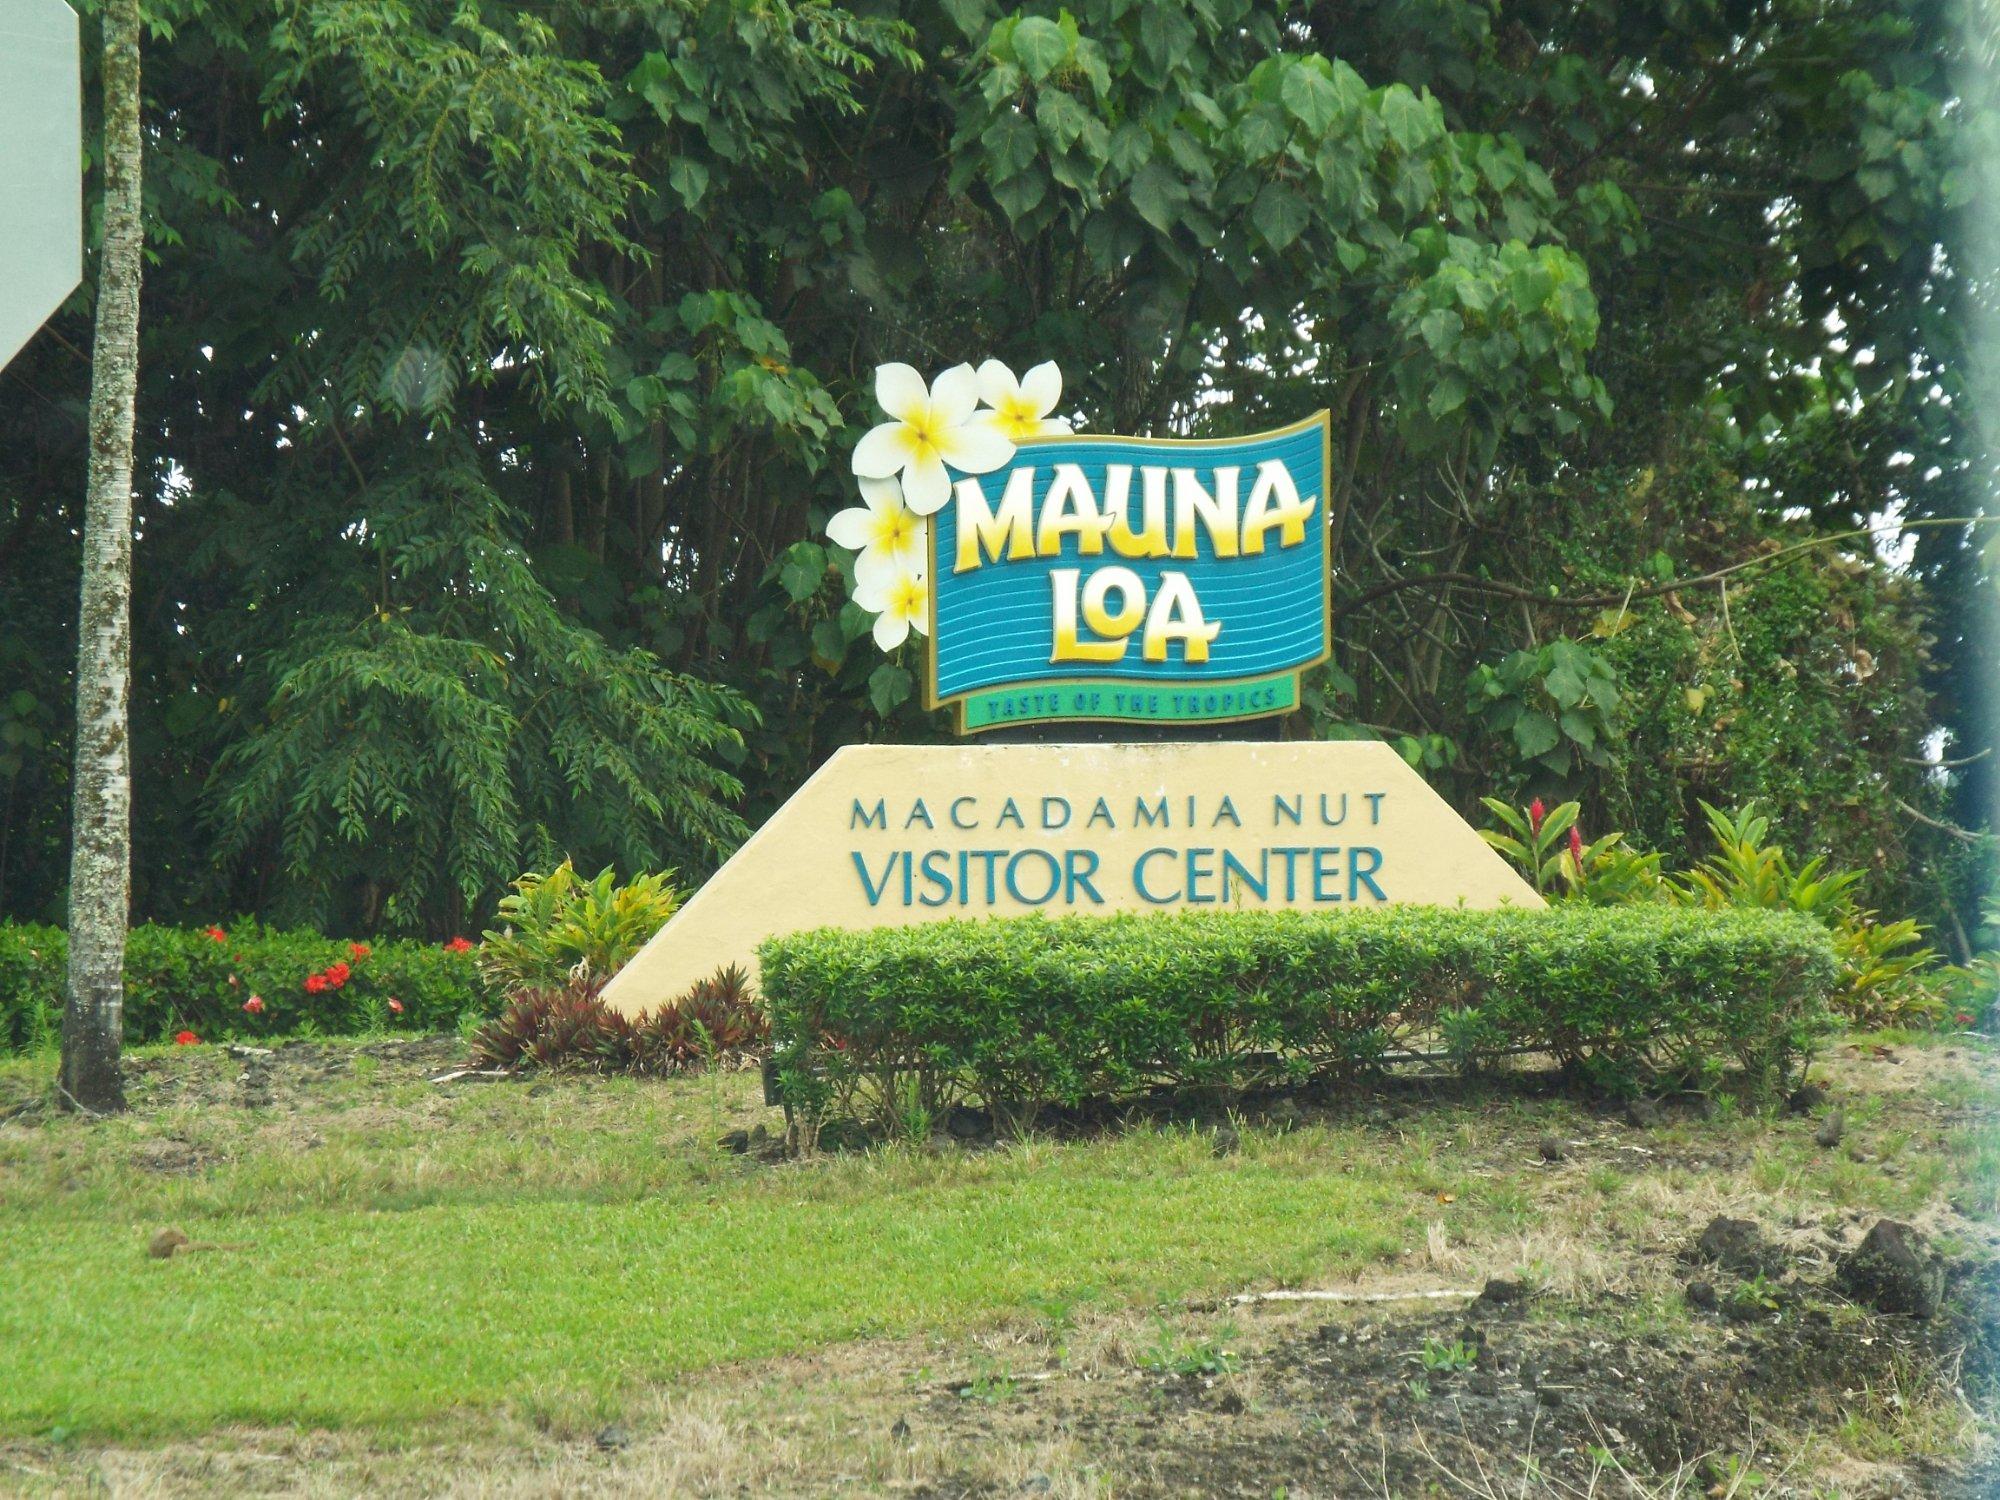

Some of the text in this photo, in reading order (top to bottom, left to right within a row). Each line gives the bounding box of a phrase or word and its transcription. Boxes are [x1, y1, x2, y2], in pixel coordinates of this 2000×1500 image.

[953, 459, 1317, 574] MAUNA
[1049, 565, 1222, 664] LOA
[988, 687, 1275, 719] TASTE OF THE TROPICS
[850, 793, 1386, 830] MACADAMIA NUT
[851, 846, 1388, 907] VISITOR CENTER
